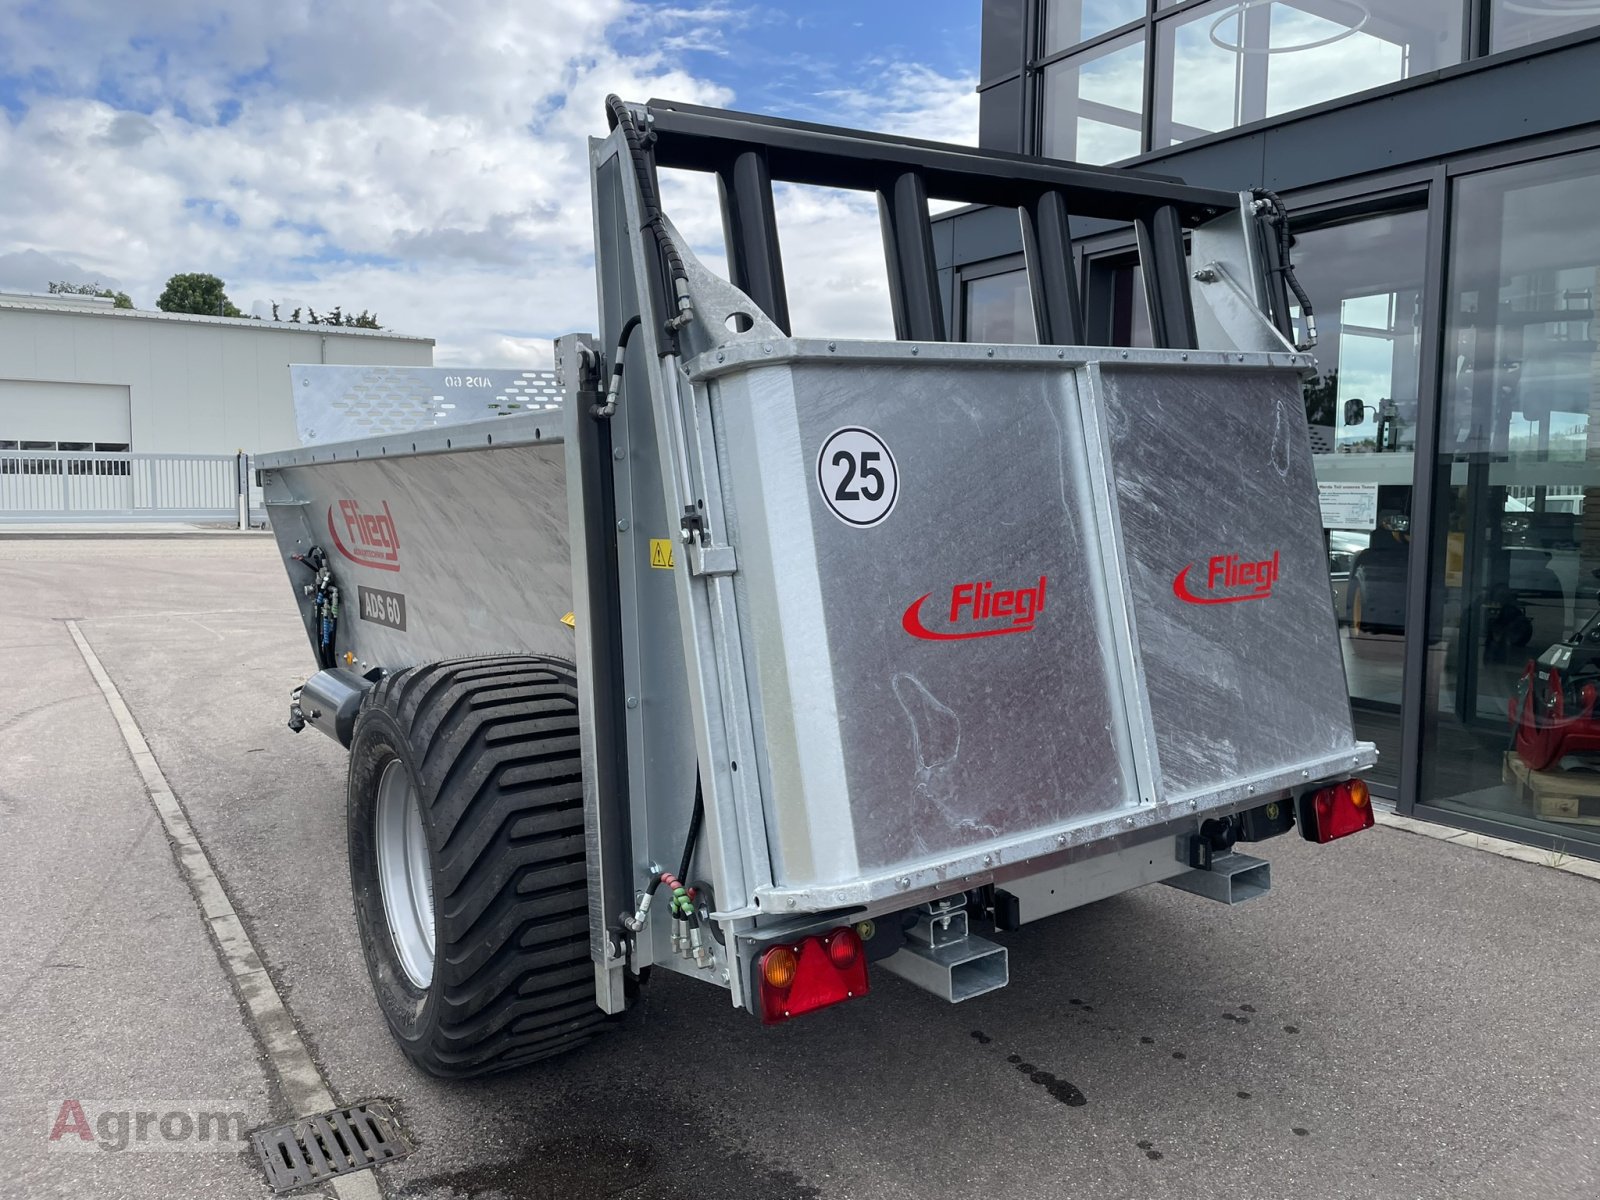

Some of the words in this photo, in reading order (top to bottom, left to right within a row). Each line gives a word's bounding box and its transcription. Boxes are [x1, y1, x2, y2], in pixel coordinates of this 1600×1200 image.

[832, 450, 885, 502] 25
[338, 499, 400, 561] Fliegl
[1207, 550, 1280, 594] Fliegl
[365, 592, 385, 620] ADS
[386, 596, 400, 625] 60
[950, 576, 1047, 625] Fliegl
